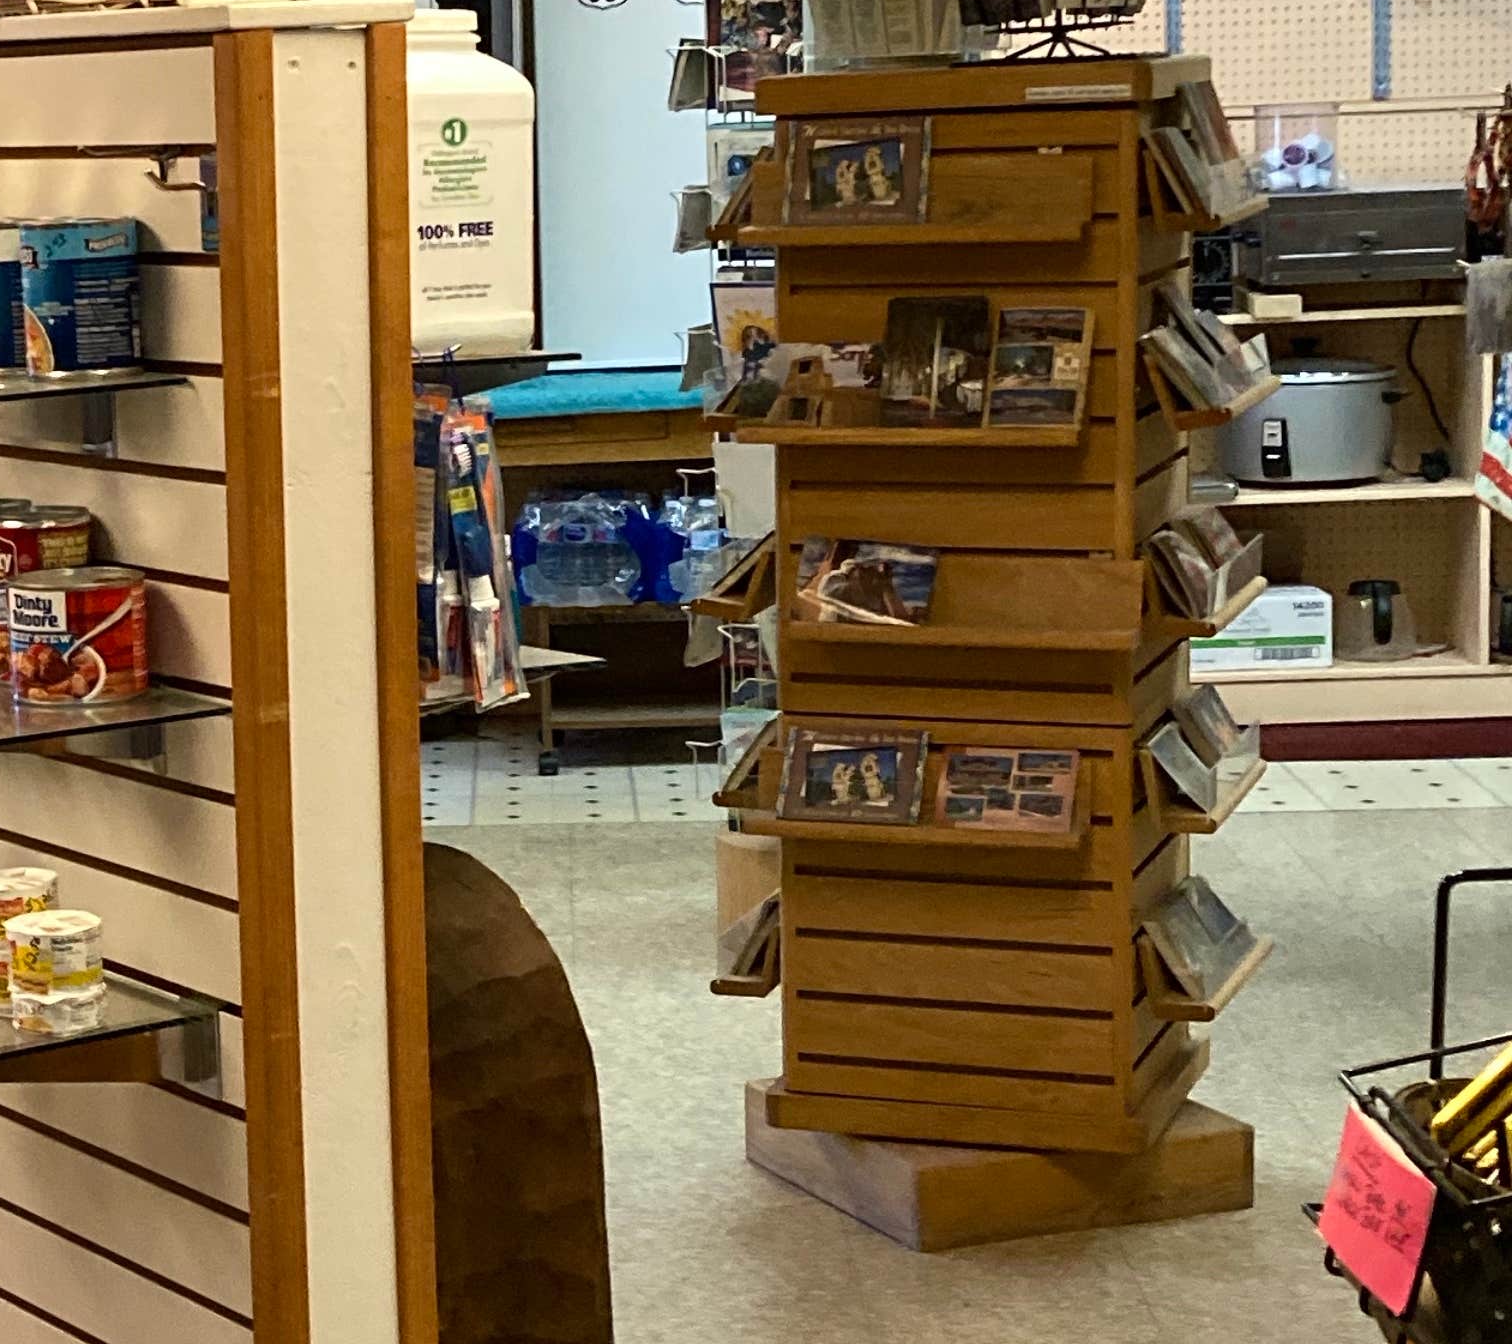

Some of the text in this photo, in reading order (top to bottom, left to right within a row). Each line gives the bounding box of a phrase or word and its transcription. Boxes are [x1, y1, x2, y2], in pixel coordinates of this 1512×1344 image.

[417, 221, 494, 240] 100% FREE
[13, 593, 53, 614] Dinty
[13, 609, 59, 628] Moore
